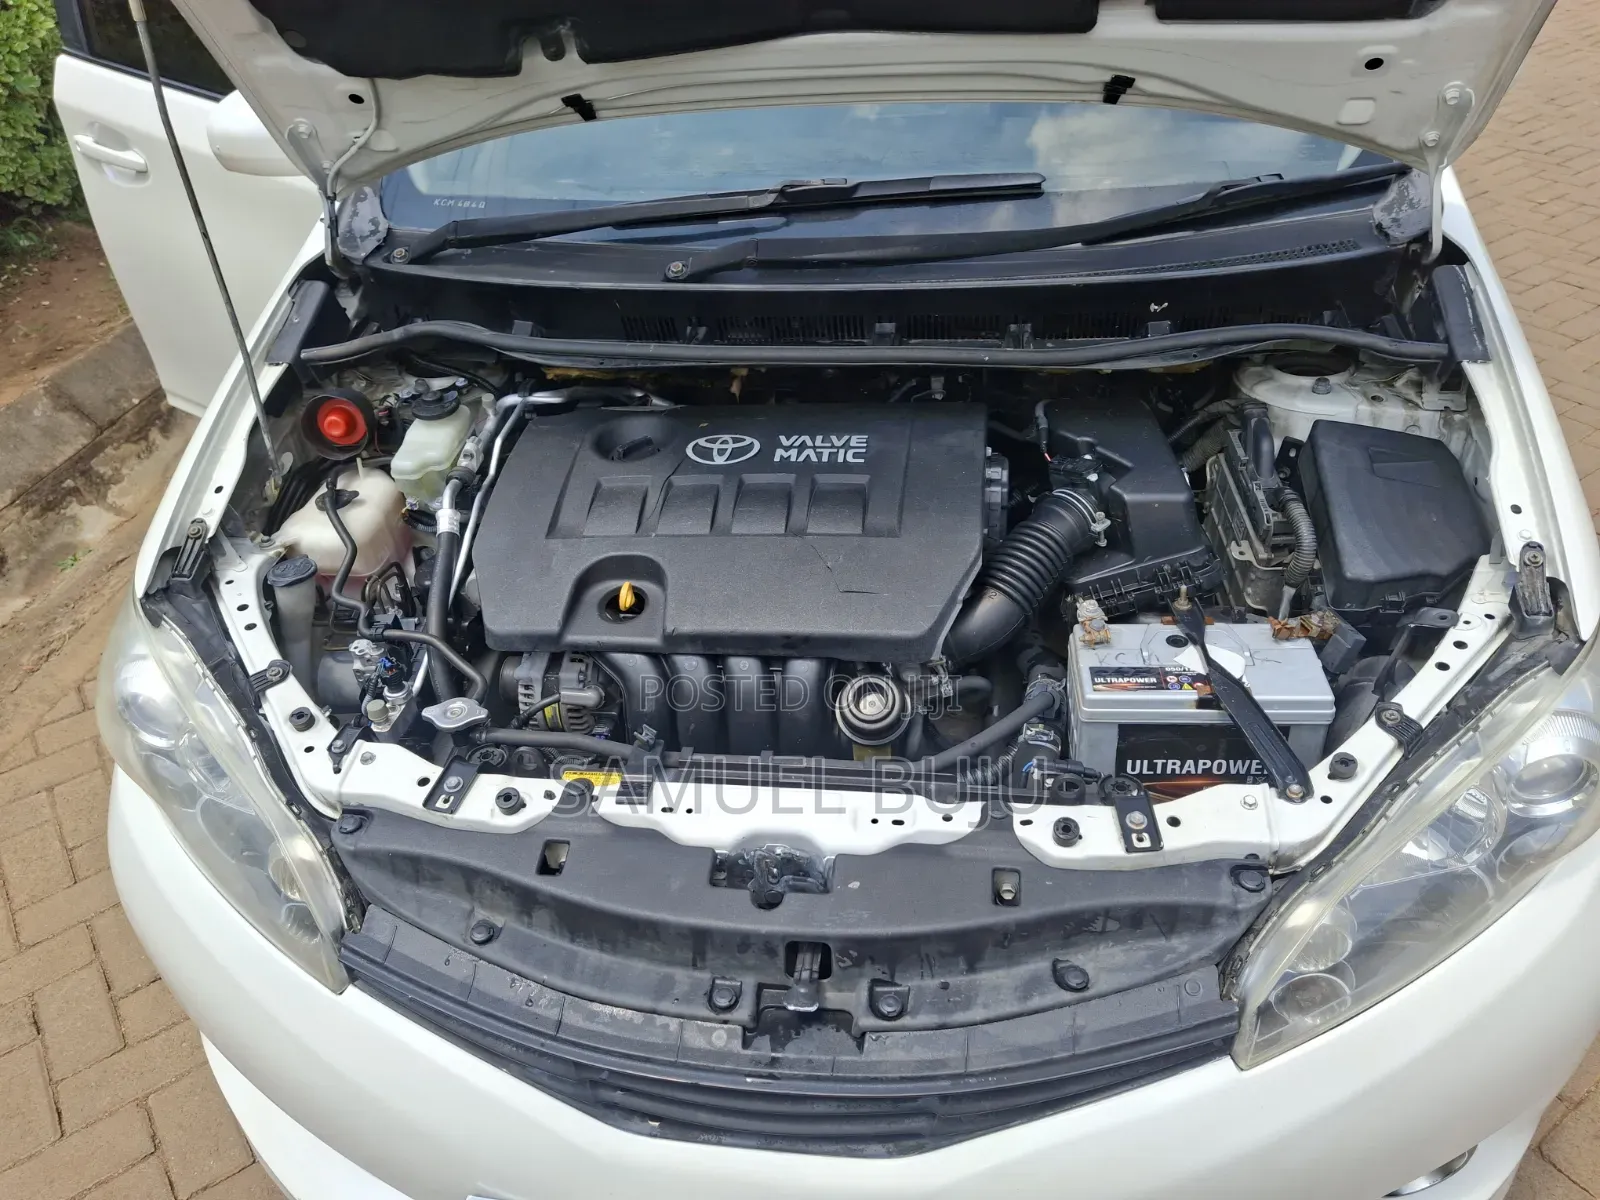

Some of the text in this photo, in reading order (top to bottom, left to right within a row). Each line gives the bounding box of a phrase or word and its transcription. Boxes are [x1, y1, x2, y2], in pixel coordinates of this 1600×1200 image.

[433, 198, 455, 207] KCM
[779, 435, 869, 447] VALVE
[773, 448, 867, 463] MATIC
[1126, 759, 1268, 775] ULTRAPOWE
